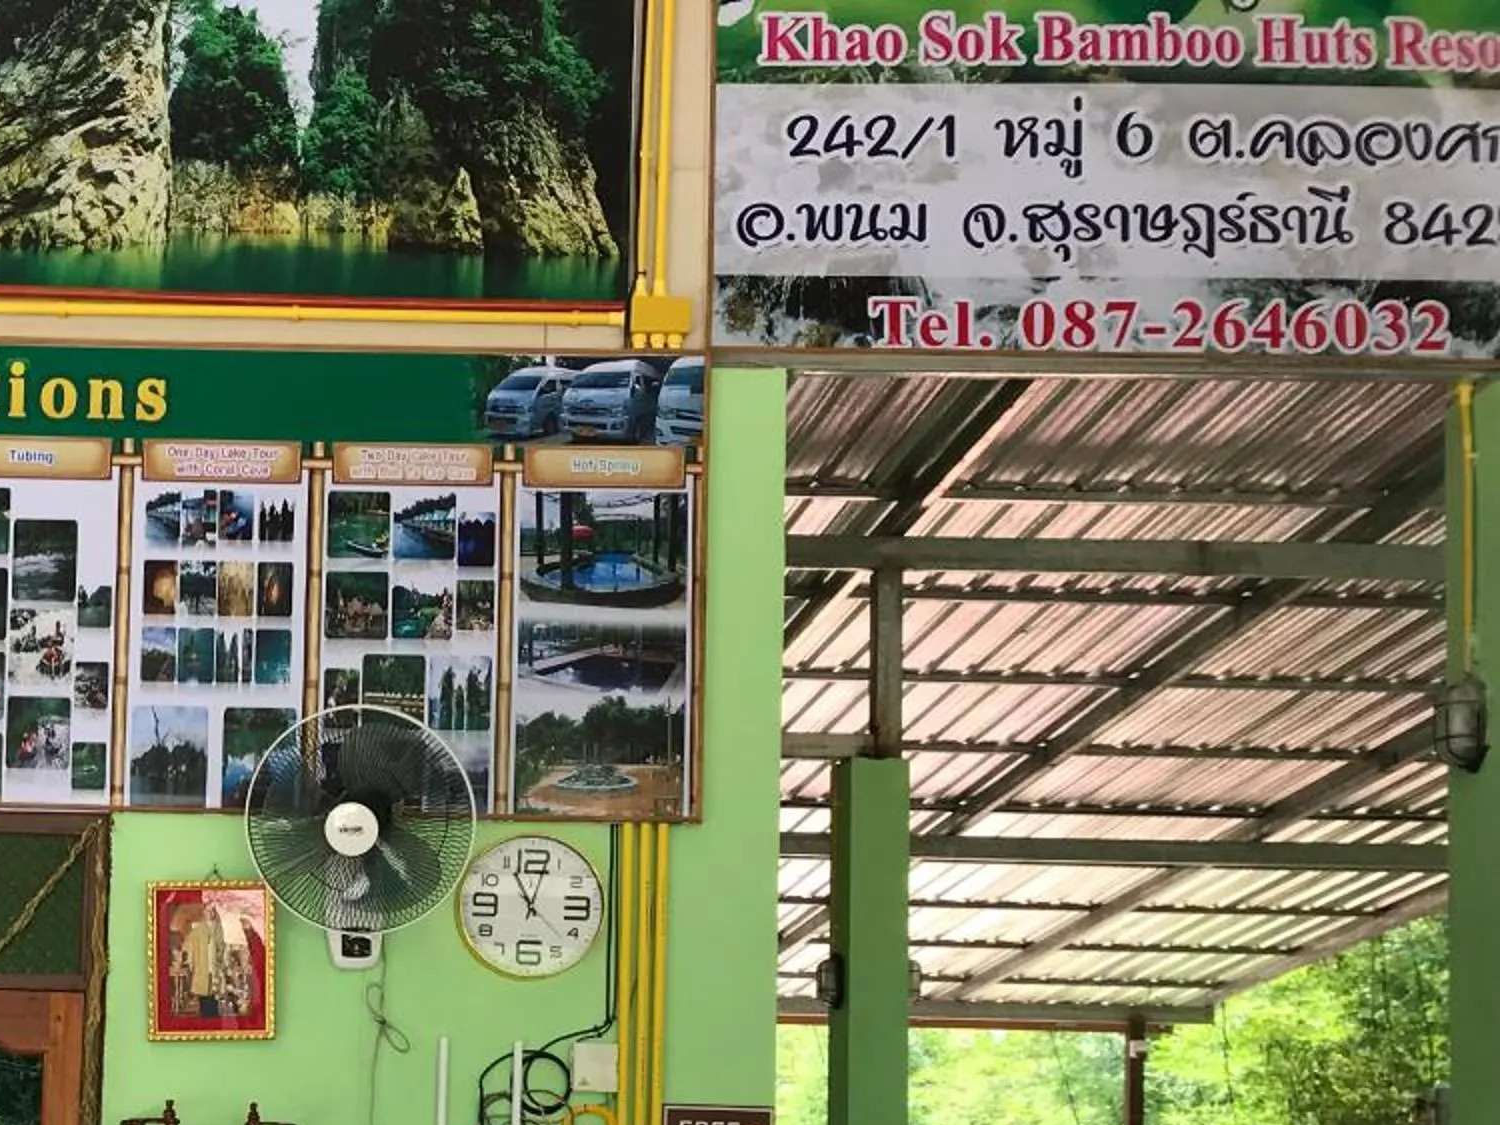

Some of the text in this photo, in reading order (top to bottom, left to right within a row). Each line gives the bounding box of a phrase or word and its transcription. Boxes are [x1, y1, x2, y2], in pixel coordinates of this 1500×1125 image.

[762, 17, 902, 63] Khao
[924, 18, 1019, 62] Sok
[1037, 18, 1239, 65] Bamboo
[1259, 19, 1373, 66] Huts
[787, 114, 957, 158] 242/1
[995, 97, 1084, 178] หมู่
[1116, 111, 1154, 158] 6
[737, 186, 1499, 260] อ.พนม จ.สุราษฎร์ธานี 842
[872, 298, 1449, 351] Tel. 087-2646032
[10, 449, 53, 464] Tubing
[518, 848, 551, 875] 12
[481, 873, 499, 887] 10
[472, 892, 498, 917] 9
[564, 895, 591, 921] 3
[478, 924, 493, 937] 8
[566, 927, 579, 938] 4
[516, 940, 542, 966] 6
